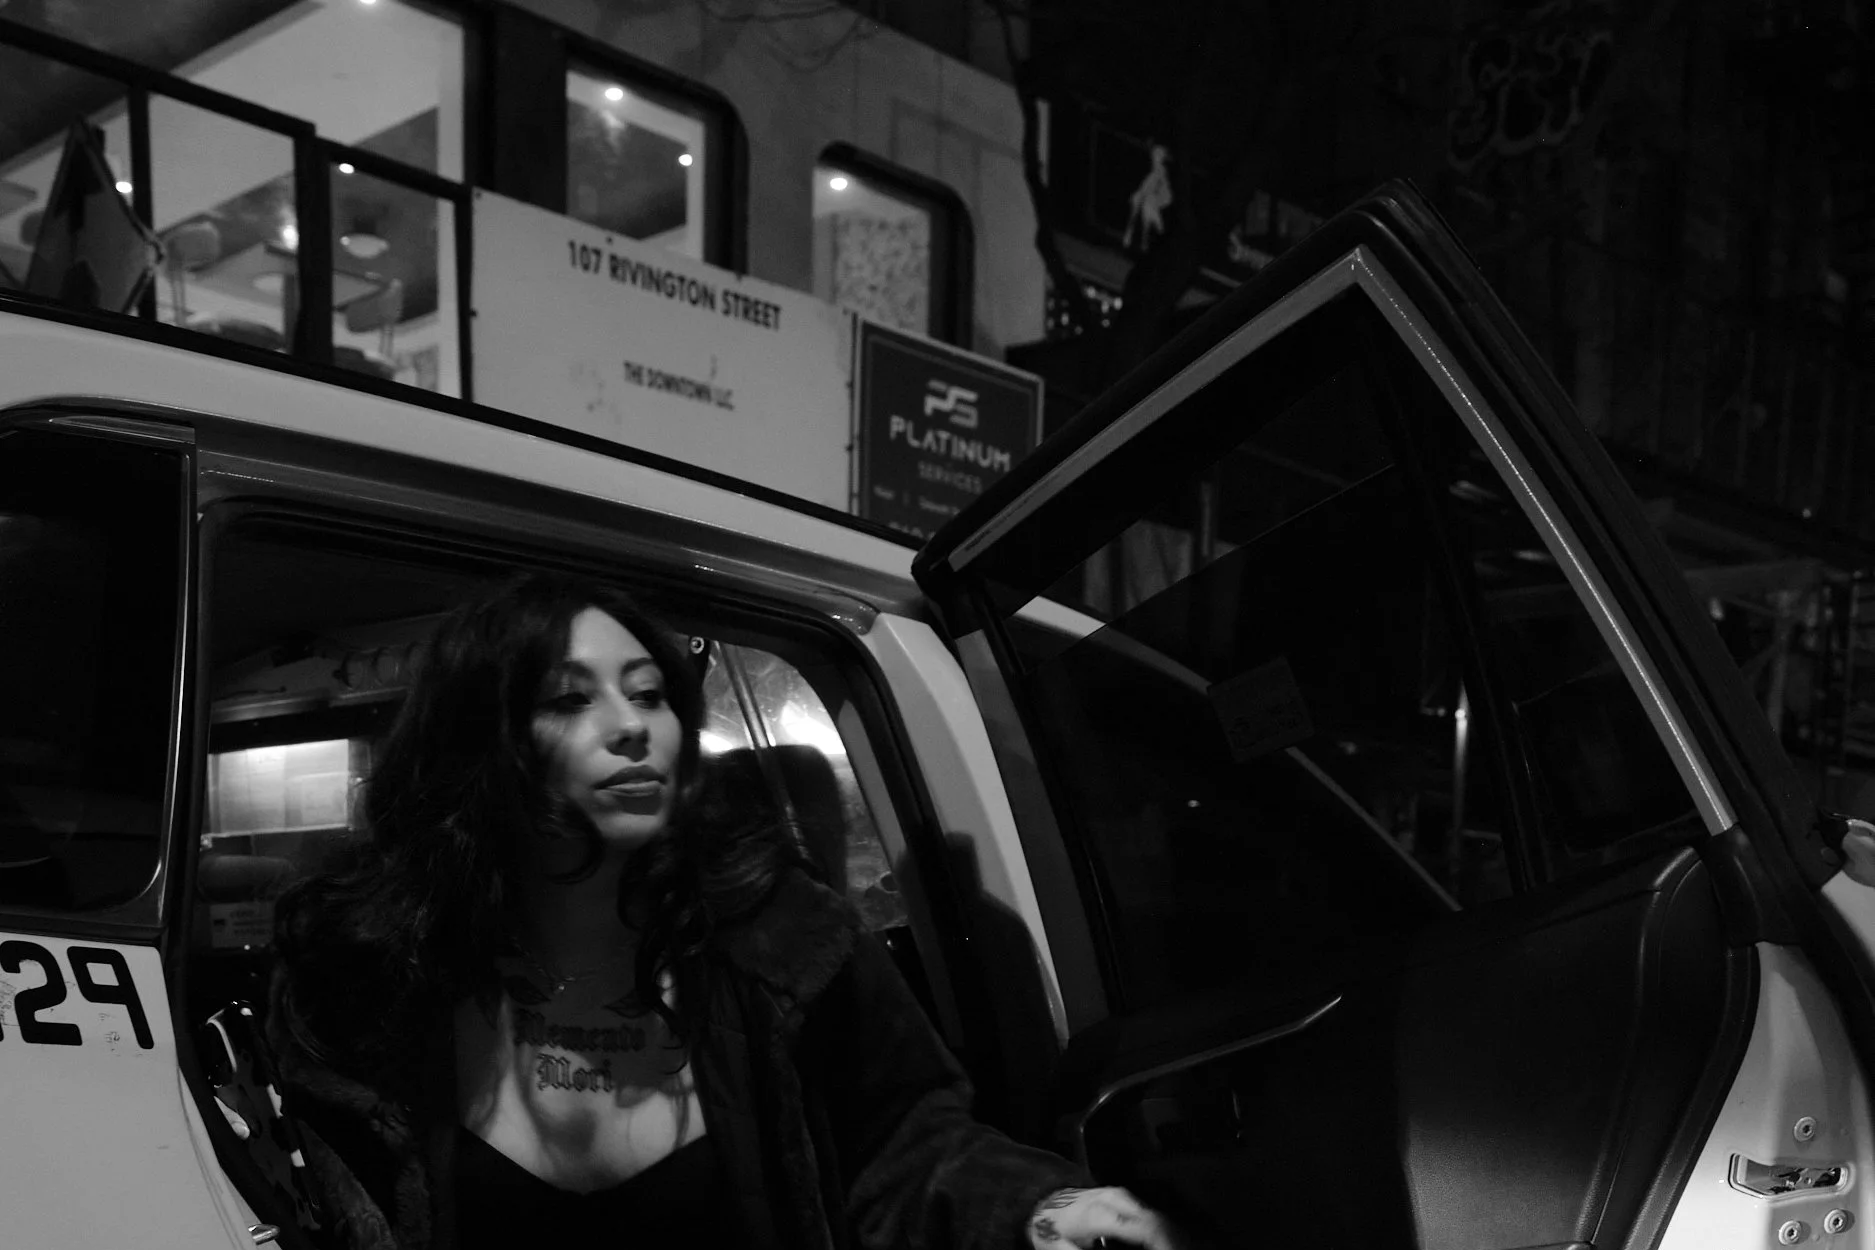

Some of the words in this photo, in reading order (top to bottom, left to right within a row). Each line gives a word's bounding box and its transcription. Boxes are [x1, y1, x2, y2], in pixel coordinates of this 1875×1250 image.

[568, 240, 602, 274] 107
[609, 253, 715, 311] RIVINGTON
[722, 289, 782, 331] STREET
[622, 360, 644, 387] THE
[889, 415, 1011, 473] PLATINUM
[0, 940, 155, 1050] 29
[536, 1053, 615, 1093] Mori
